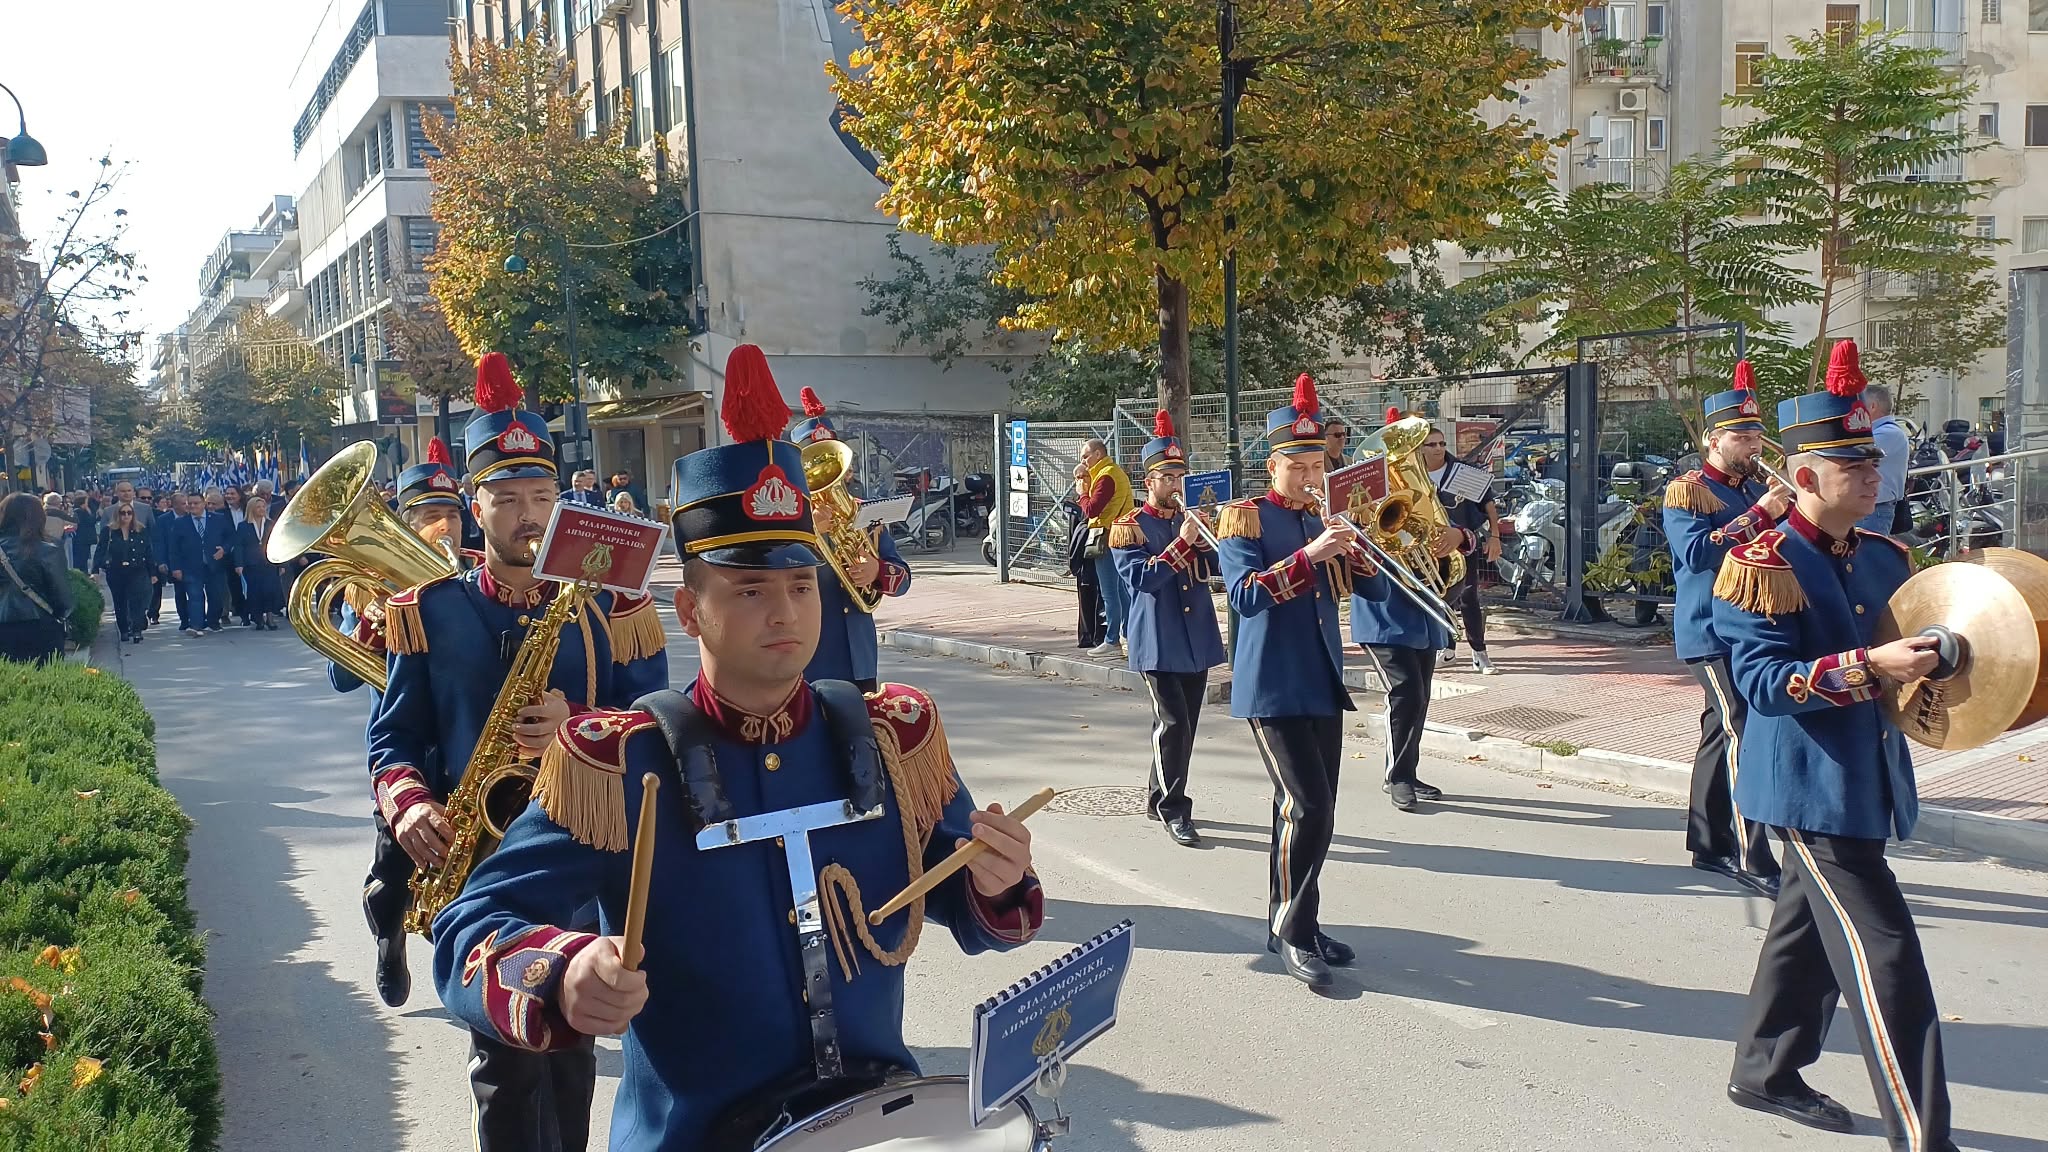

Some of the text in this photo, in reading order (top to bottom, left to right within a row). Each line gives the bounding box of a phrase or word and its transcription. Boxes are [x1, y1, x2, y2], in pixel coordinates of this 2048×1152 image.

[565, 528, 646, 549] ΔΗΜΟΥ ΛΑΡΙΣΑΙΩΝ
[578, 519, 641, 537] ΦΙΛΑΡΜΟΝΙΚΗ
[1017, 956, 1104, 1014] ΦΙΛΑΡΜΟΝΙΚΗ
